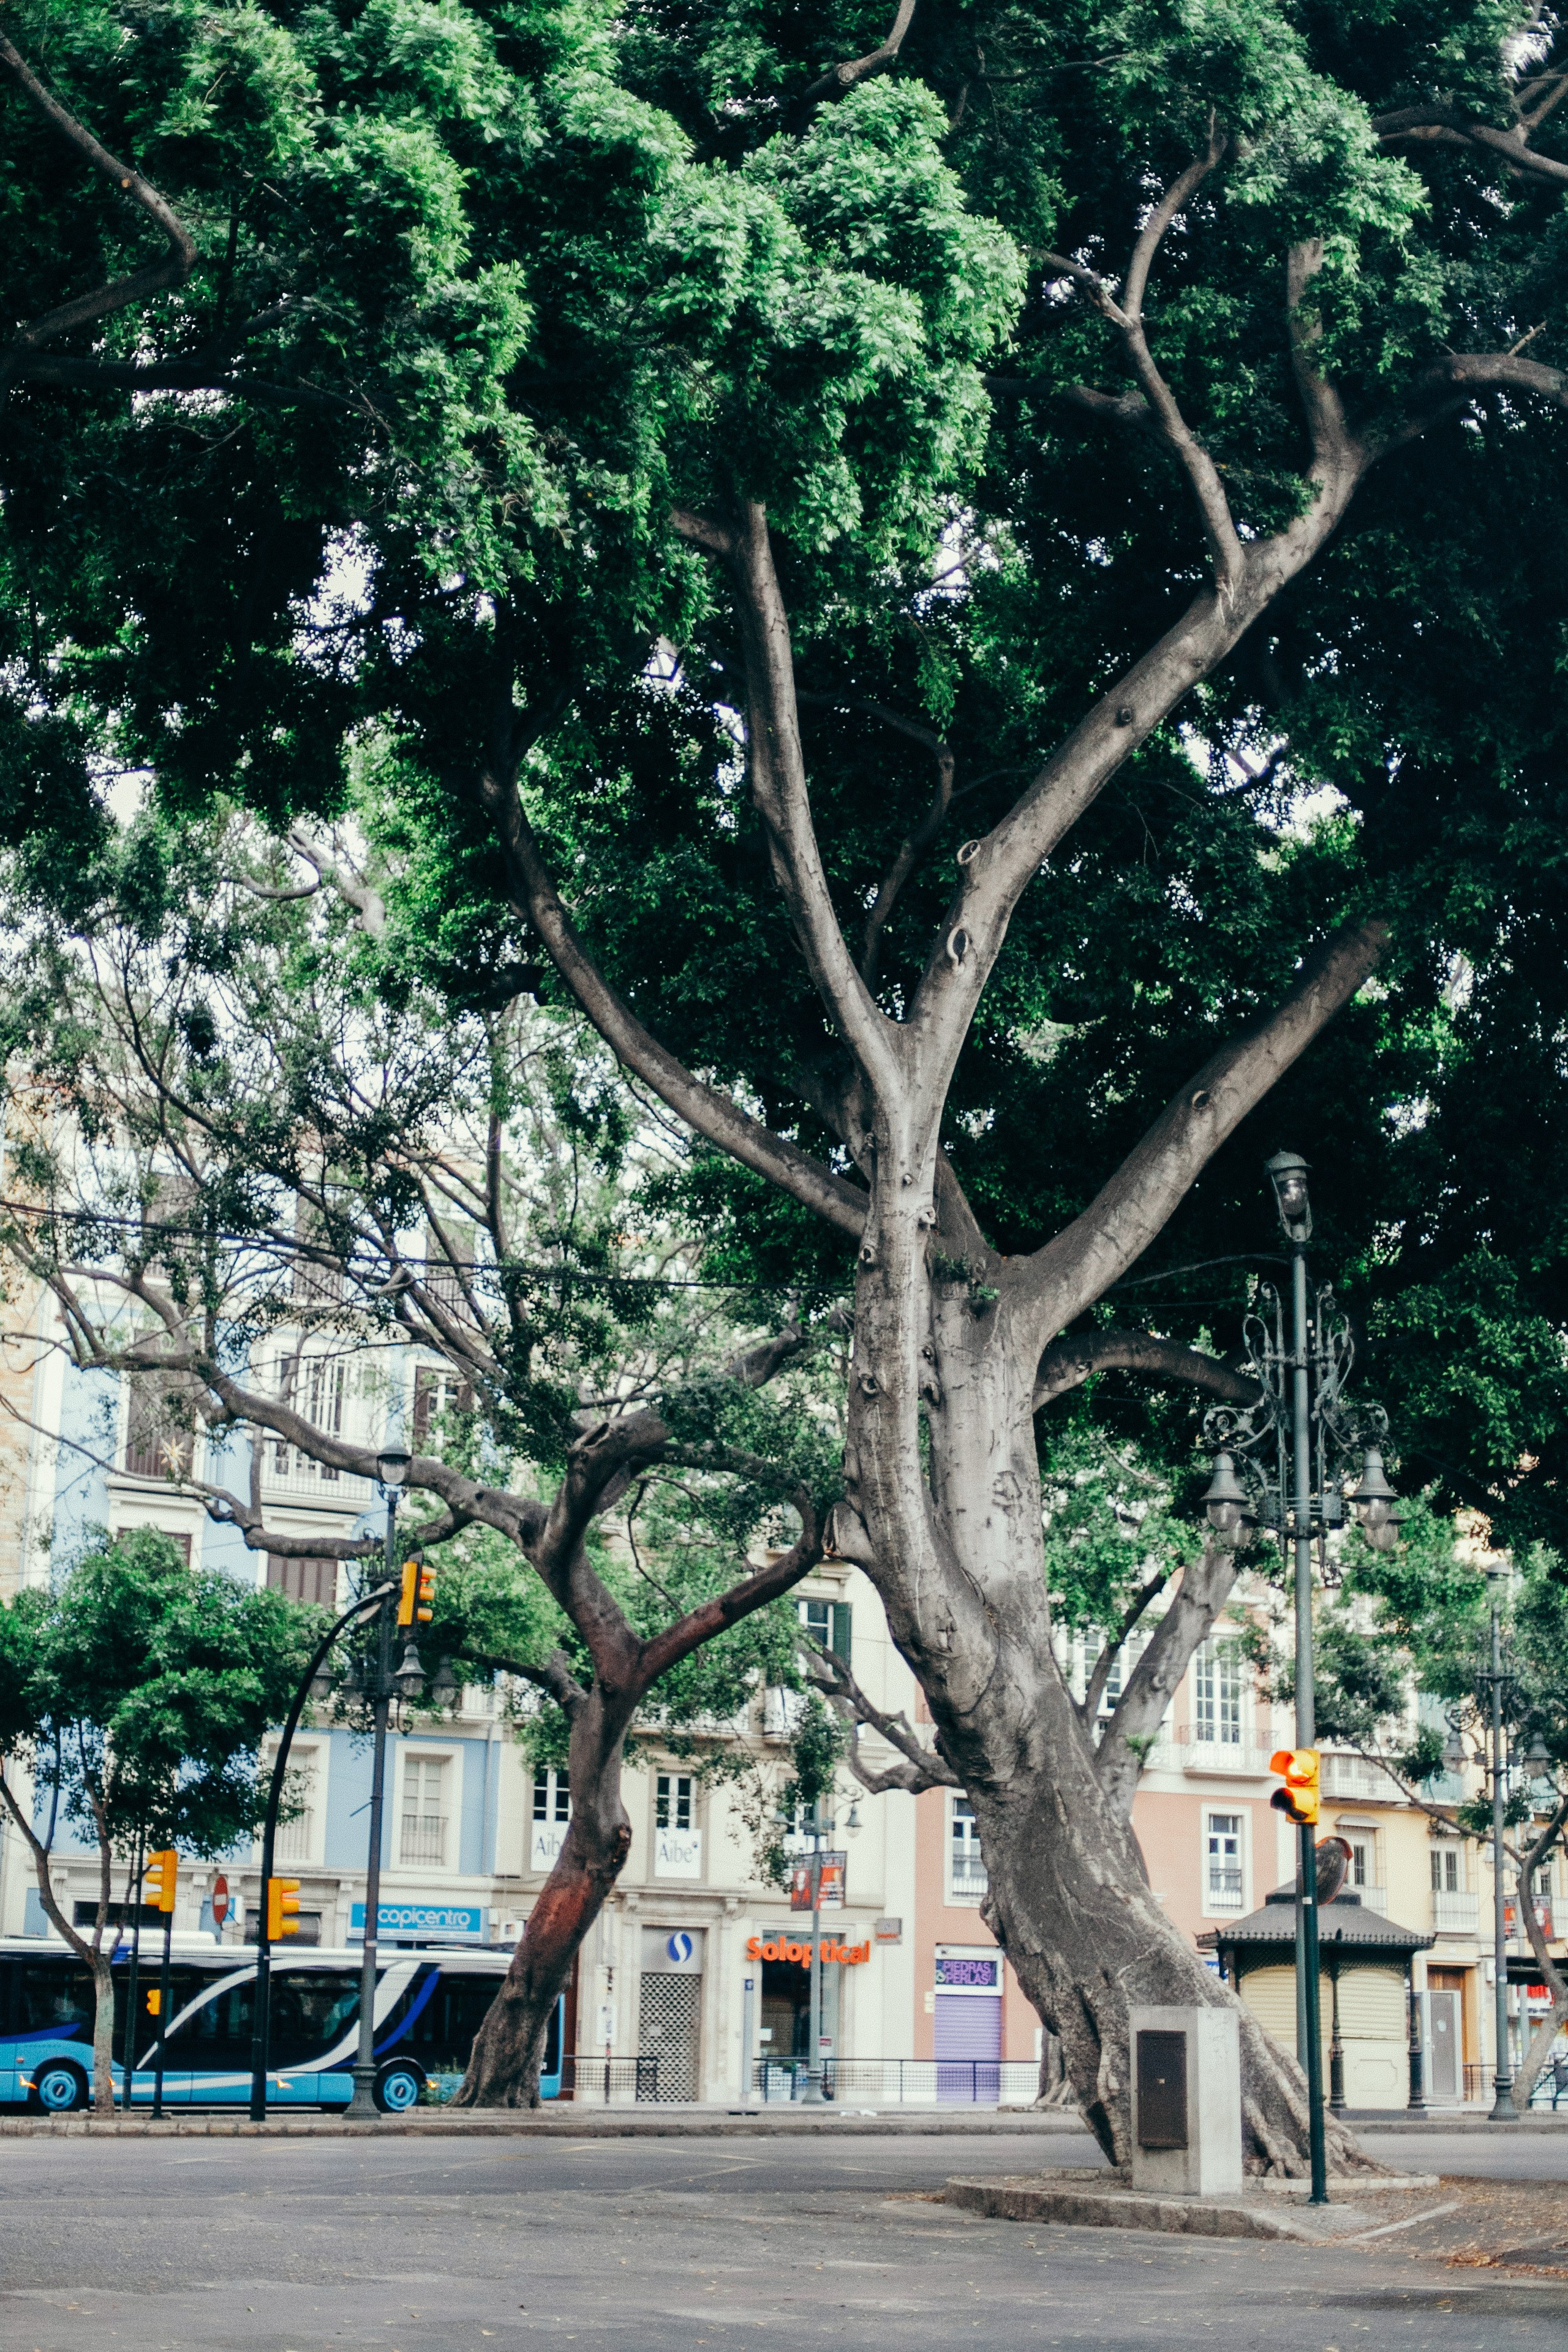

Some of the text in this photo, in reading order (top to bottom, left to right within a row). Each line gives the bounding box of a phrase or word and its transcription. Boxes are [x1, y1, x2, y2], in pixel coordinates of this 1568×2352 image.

[378, 1908, 470, 1928] copicentro
[747, 1936, 870, 1968] Soloptical
[943, 1960, 991, 1973] PIEDRAS
[945, 1972, 990, 1985] PERLAS
